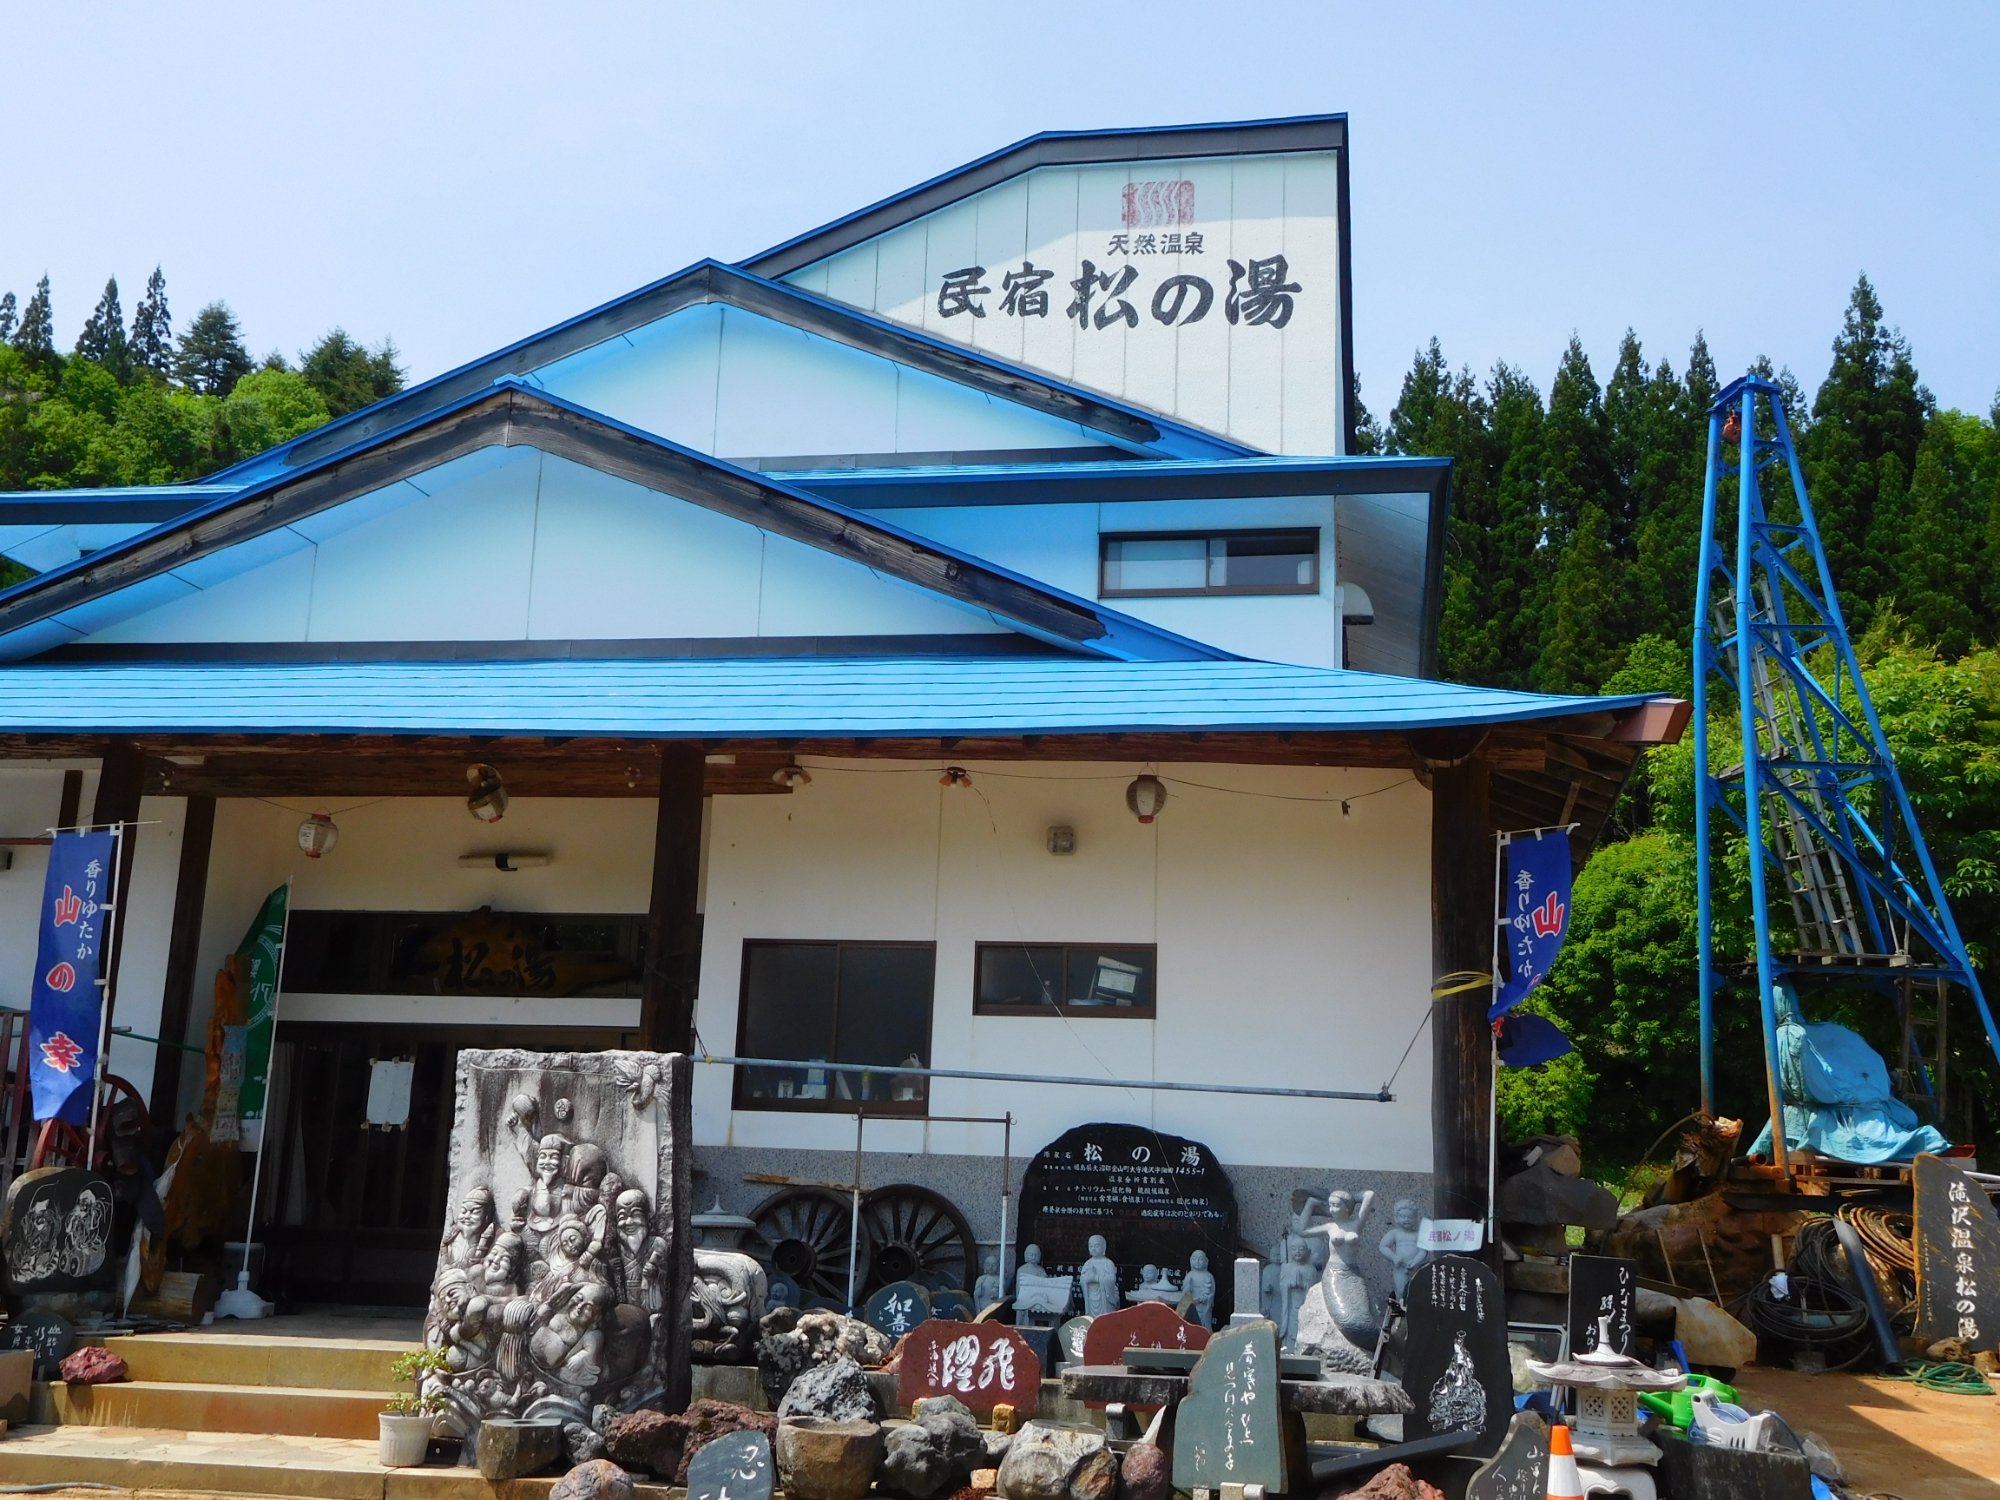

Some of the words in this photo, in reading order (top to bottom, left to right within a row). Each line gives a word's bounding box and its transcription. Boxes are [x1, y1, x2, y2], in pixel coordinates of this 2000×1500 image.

[1107, 231, 1206, 256] 天然温泉
[936, 254, 1303, 331] 民宿松の湯
[76, 858, 103, 962] 香りゆたか
[40, 884, 82, 1073] 山の幸
[1084, 1142, 1201, 1167] 松の湯
[1948, 1182, 1979, 1340] 滝沢温泉松の湯
